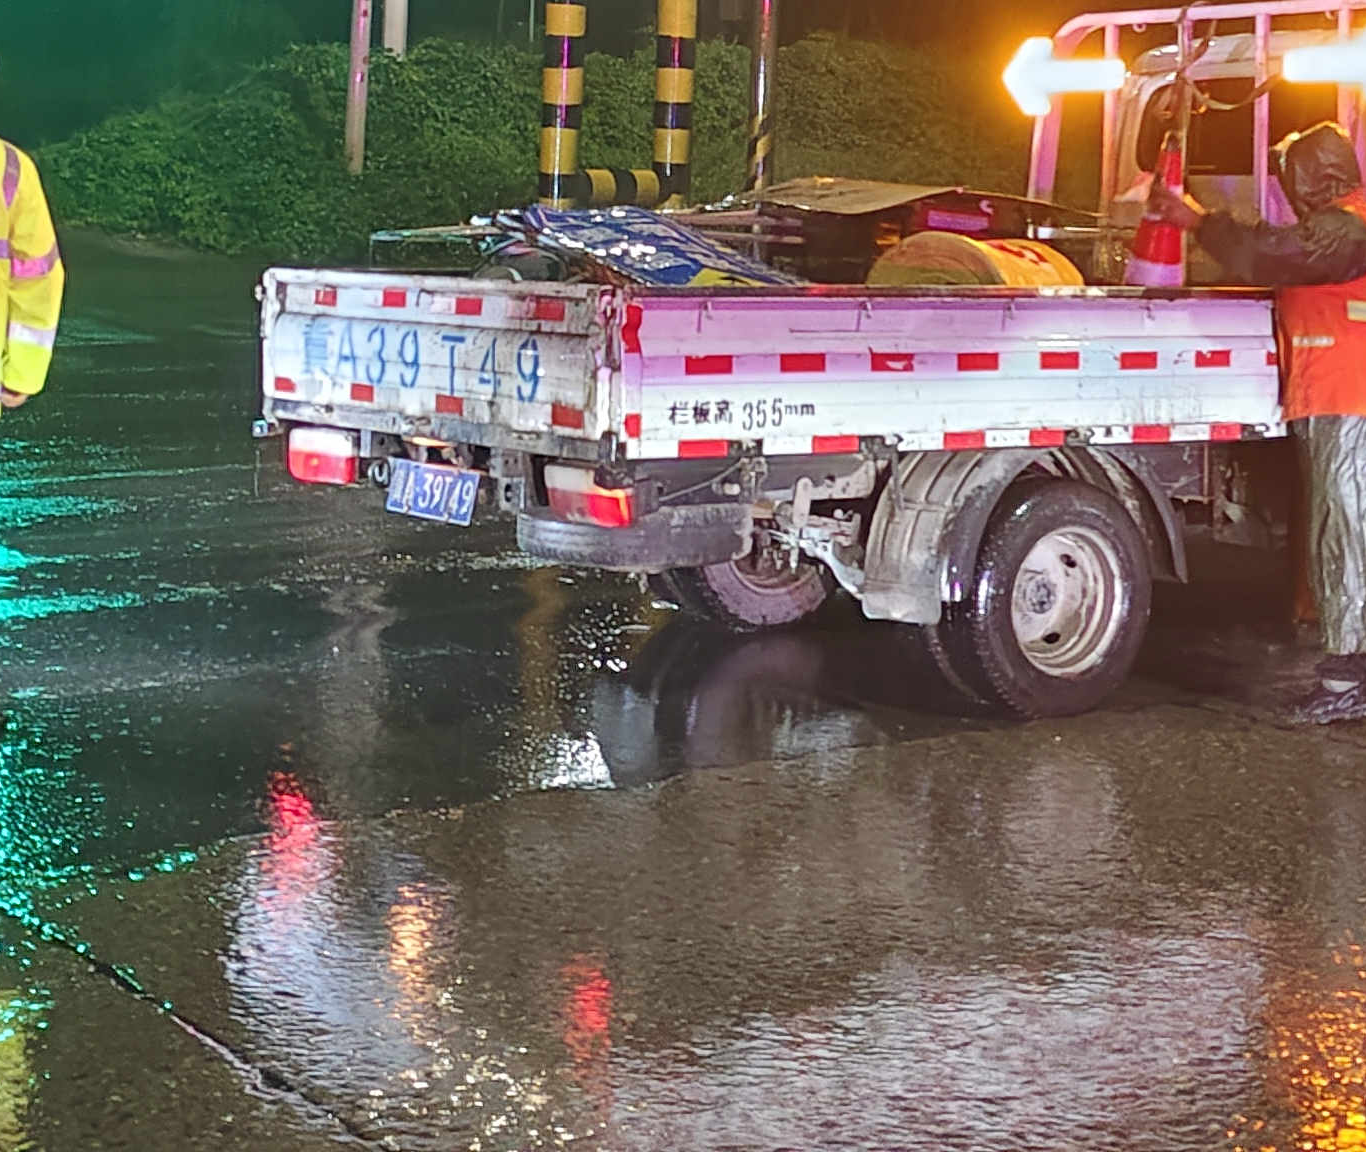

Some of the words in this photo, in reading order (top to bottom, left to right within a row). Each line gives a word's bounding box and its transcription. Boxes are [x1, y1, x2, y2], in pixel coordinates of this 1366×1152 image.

[668, 400, 734, 425] 栏板高
[742, 398, 816, 431] 355mm
